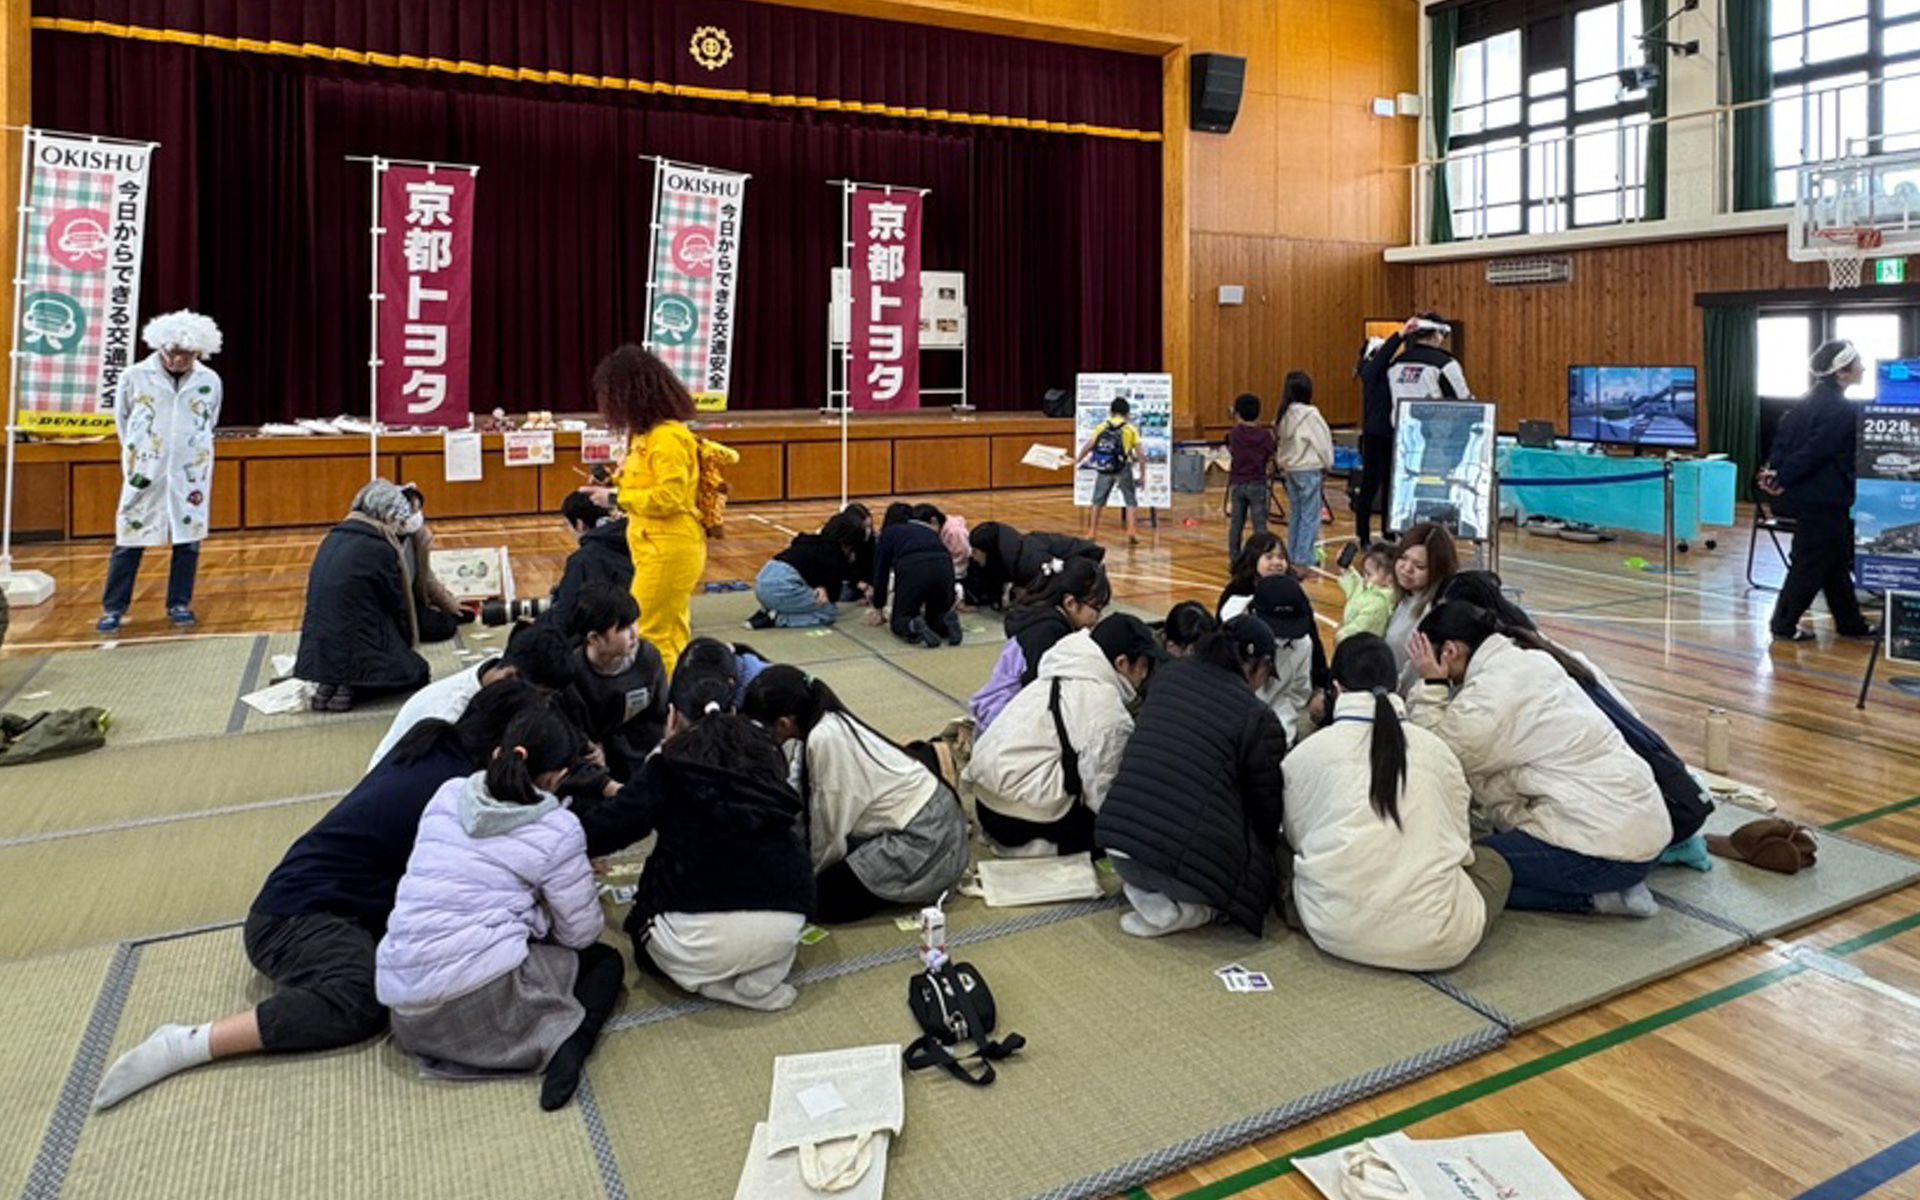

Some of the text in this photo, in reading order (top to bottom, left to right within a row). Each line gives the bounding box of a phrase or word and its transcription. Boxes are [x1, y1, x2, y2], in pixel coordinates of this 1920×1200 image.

[41, 145, 145, 172] OKISHU
[667, 173, 740, 198] OKISHU
[402, 181, 455, 414] 京都トヨタ
[708, 203, 737, 390] 今日からできる交通安全
[866, 201, 907, 400] 京都トヨタ
